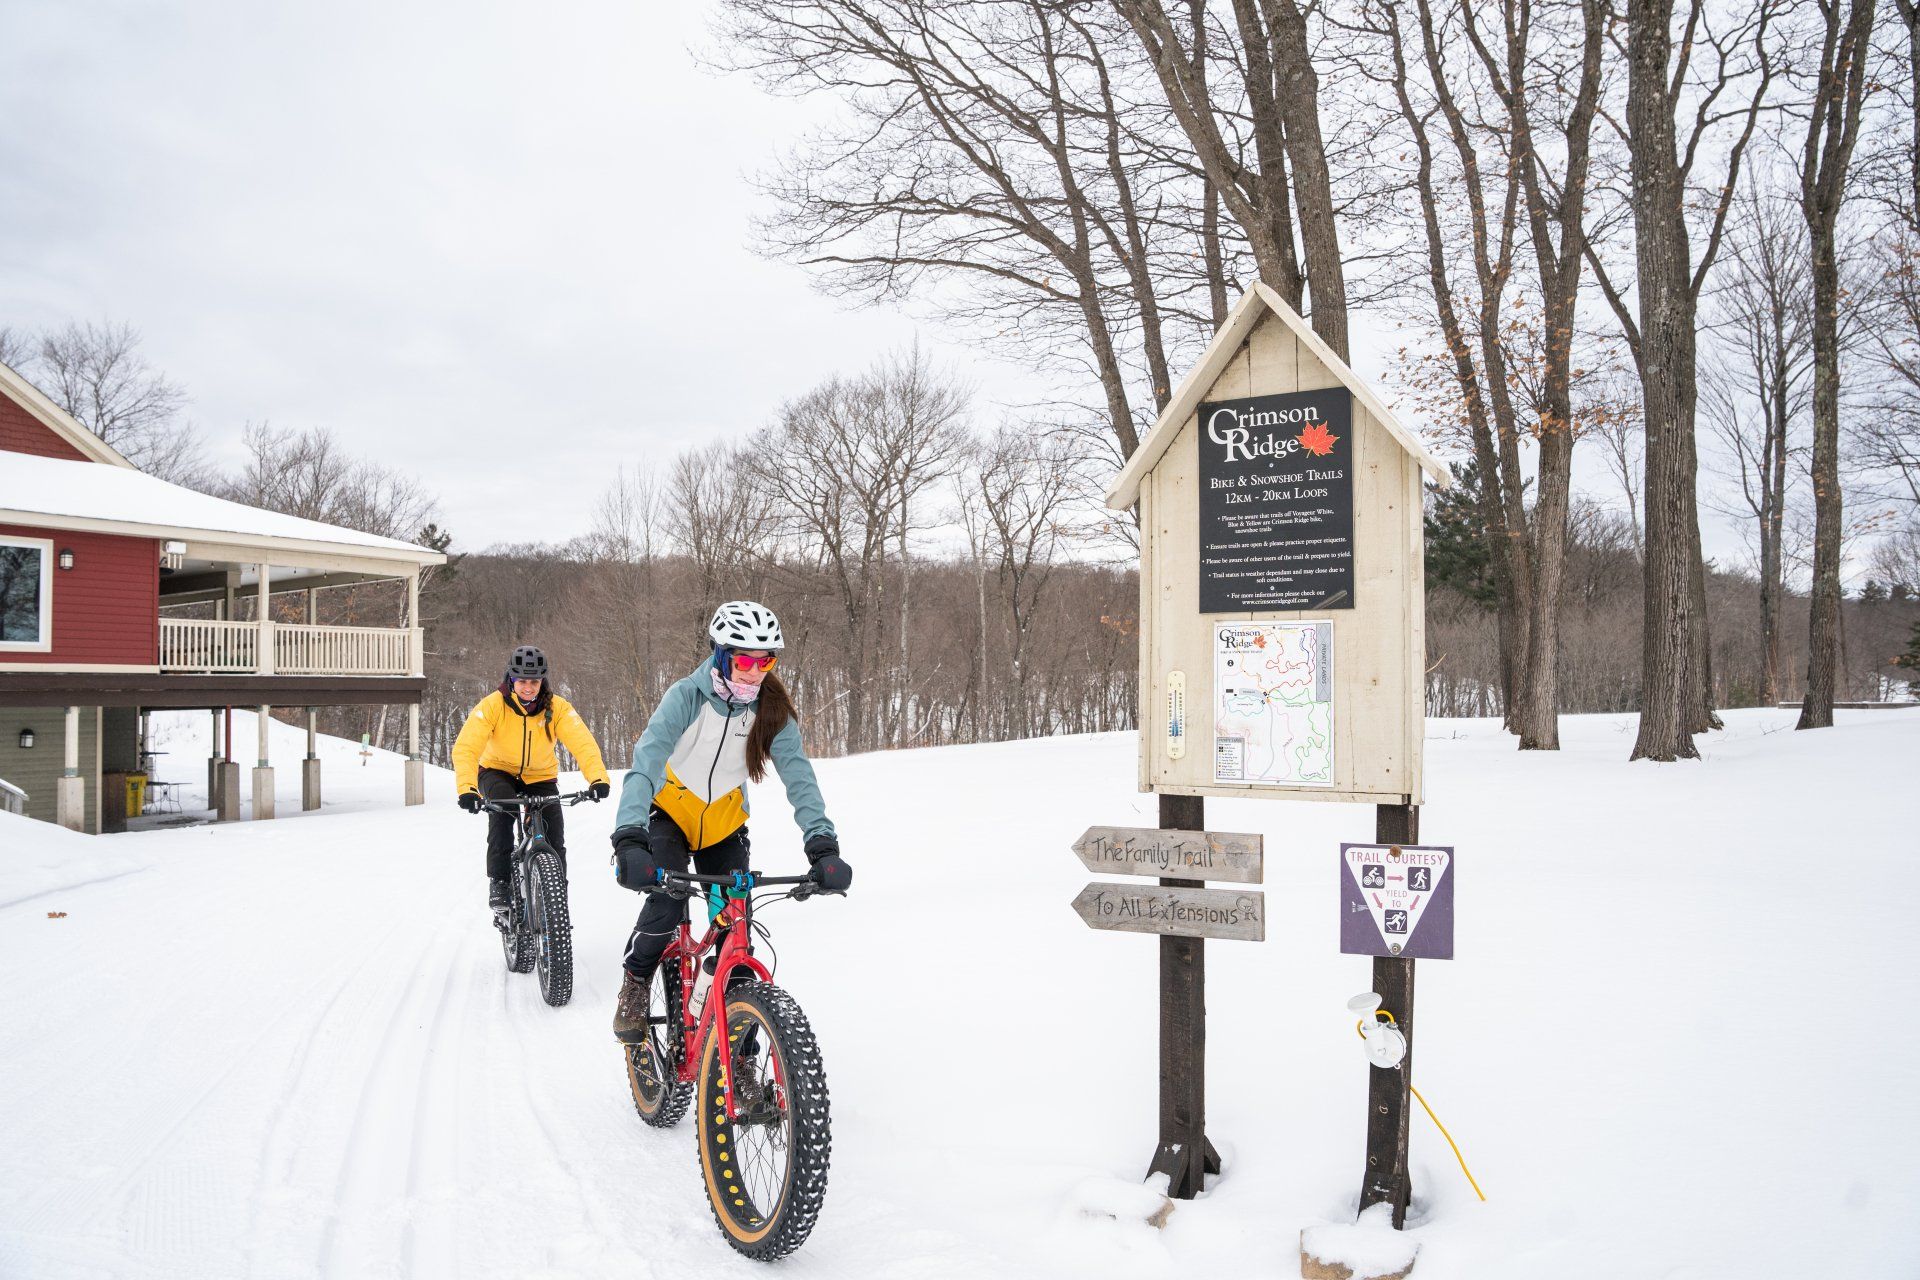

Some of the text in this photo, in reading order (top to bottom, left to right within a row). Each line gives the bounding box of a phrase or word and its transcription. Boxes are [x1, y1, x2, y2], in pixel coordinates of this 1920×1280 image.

[1208, 406, 1319, 445] Crimson
[1222, 428, 1298, 462] Ridge
[1210, 470, 1343, 488] BIKE & SNOWSHOE TRAILS
[1294, 488, 1328, 499] LOOPS
[1219, 629, 1260, 642] Crimson
[1226, 636, 1254, 648] Ridge
[1173, 842, 1213, 867] Trail
[1350, 852, 1444, 866] TRAIL COURTESY
[1386, 890, 1408, 898] YIELD
[1118, 896, 1140, 918] All
